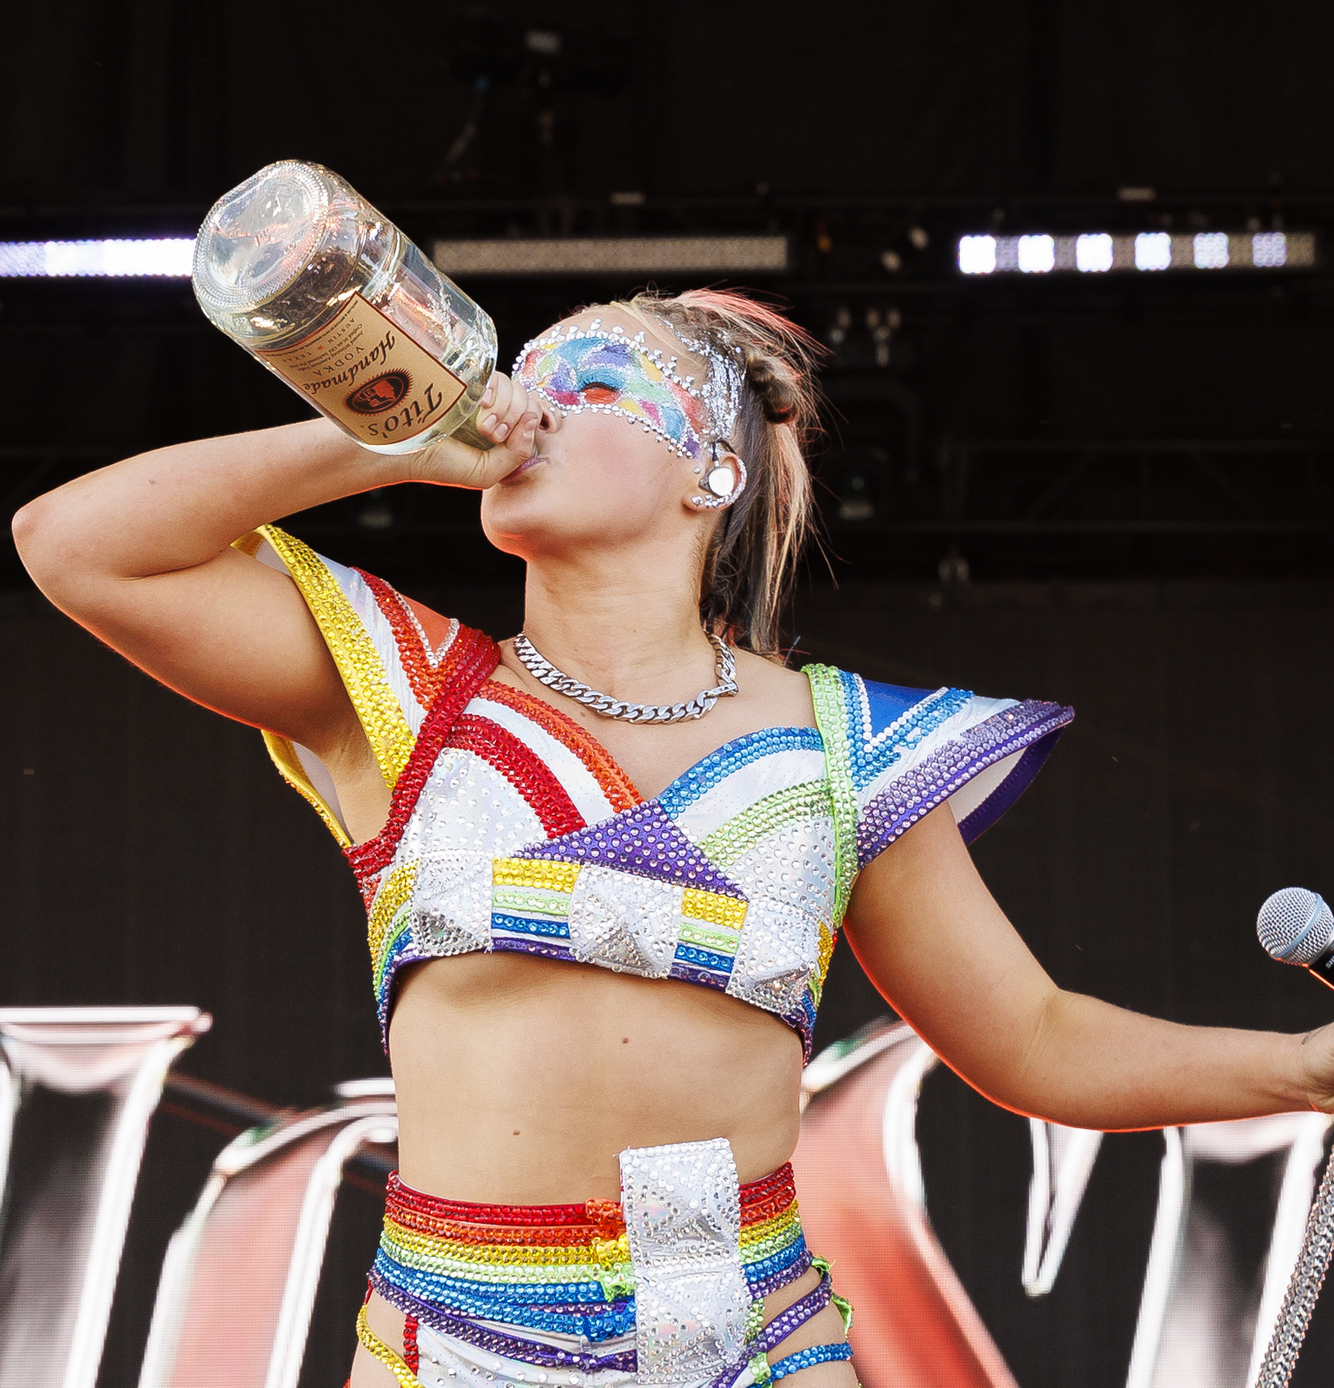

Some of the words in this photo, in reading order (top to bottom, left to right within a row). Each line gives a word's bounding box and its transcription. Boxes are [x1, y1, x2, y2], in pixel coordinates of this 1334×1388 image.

[327, 317, 355, 346] AUSTIN
[303, 330, 396, 395] Handmade
[315, 346, 365, 377] VODKA
[369, 383, 443, 438] Tito's
